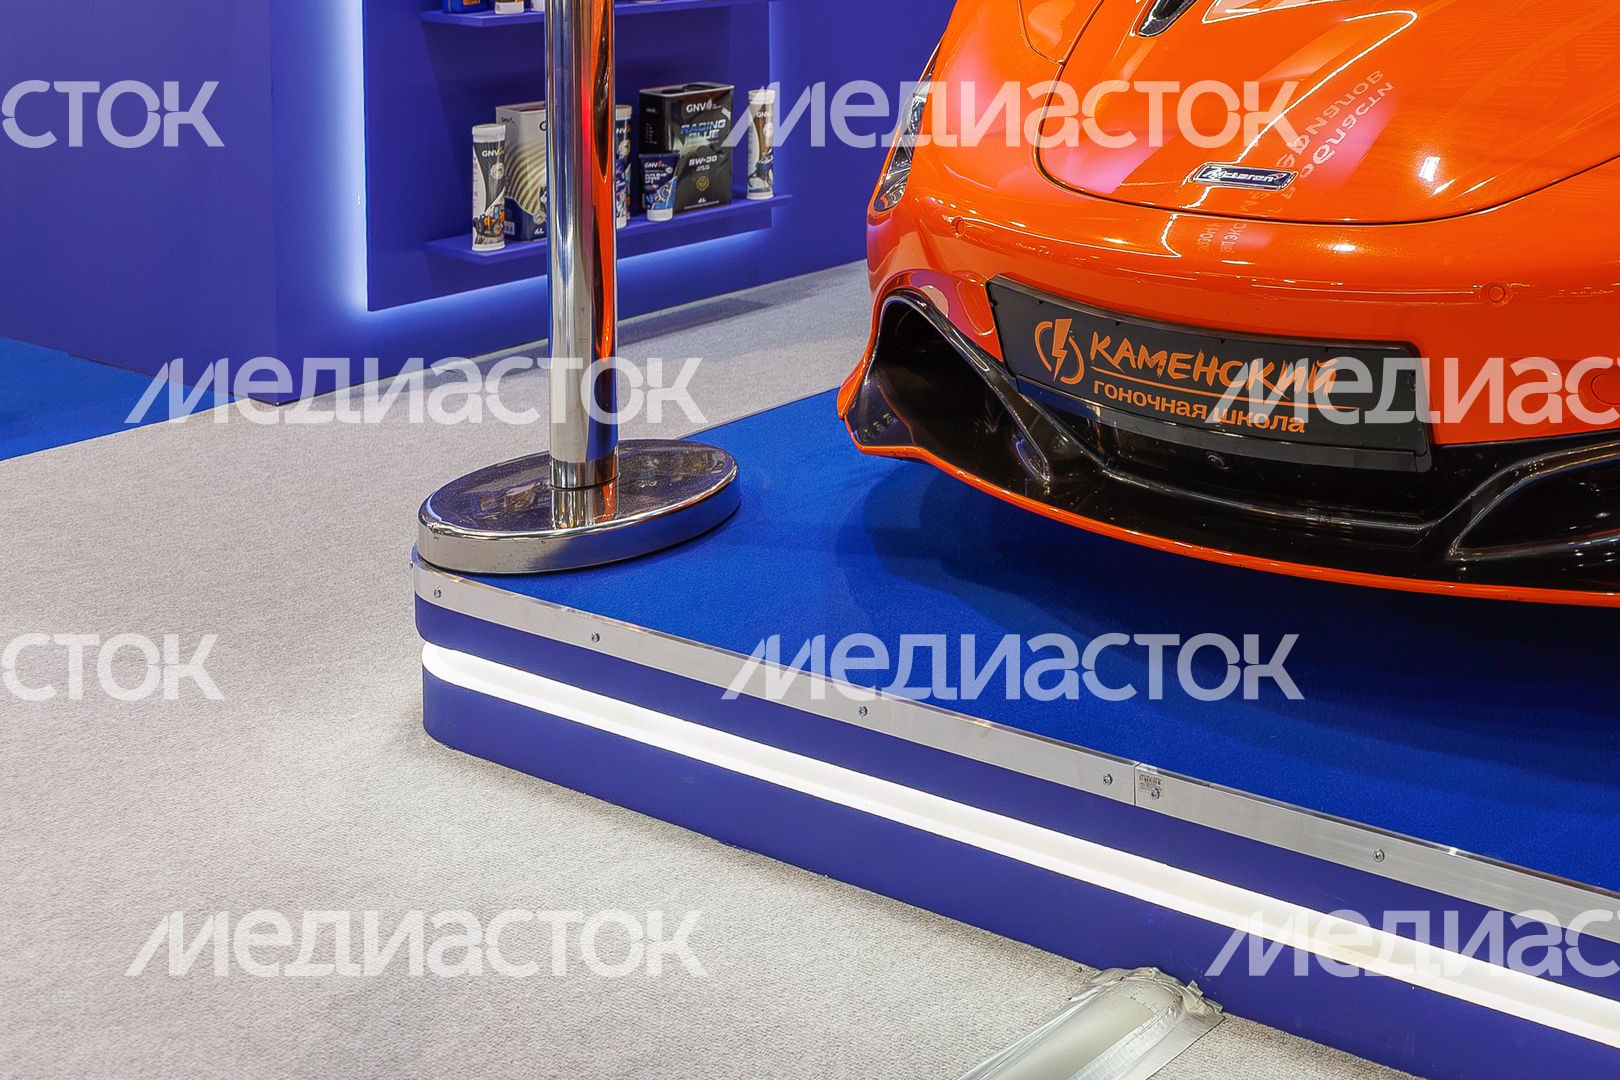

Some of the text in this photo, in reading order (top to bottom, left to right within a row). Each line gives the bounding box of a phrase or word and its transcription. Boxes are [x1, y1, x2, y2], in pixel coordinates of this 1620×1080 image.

[686, 101, 706, 113] GNV
[680, 119, 726, 134] RACING
[482, 149, 499, 157] GNV
[1090, 331, 1340, 398] КАМЕНСКИЙ
[1093, 379, 1305, 434] гоночная школа
